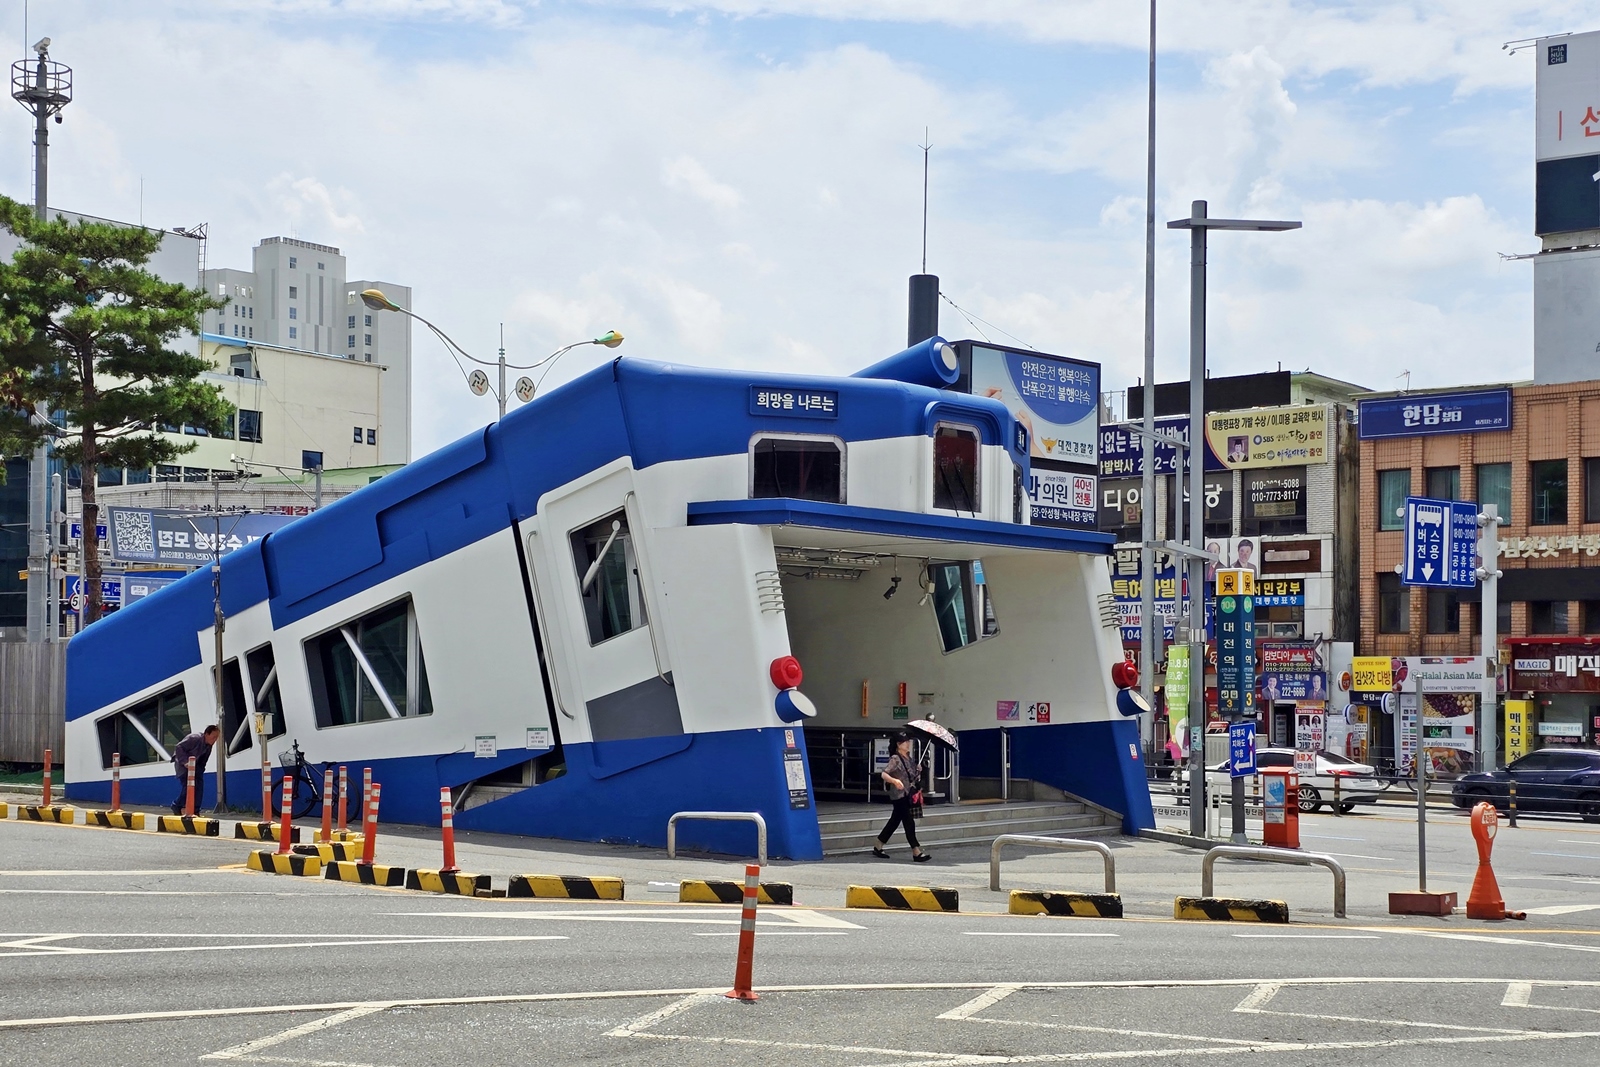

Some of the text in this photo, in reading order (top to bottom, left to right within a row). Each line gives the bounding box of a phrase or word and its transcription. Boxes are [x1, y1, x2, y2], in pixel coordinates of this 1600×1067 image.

[1021, 361, 1091, 387] 안전운전 행복약속
[1021, 380, 1091, 405] 난폭운전 불행약속
[757, 392, 834, 412] 희망을 나르는
[1212, 417, 1240, 431] 대통령표창
[1254, 415, 1267, 428] 수상
[1292, 411, 1310, 423] 교육학
[1311, 410, 1324, 421] 박사
[1402, 404, 1443, 427] 한담
[1309, 430, 1323, 440] 출연
[1058, 440, 1094, 455] 대전경찰청
[1309, 447, 1323, 457] 출연
[1075, 479, 1092, 491] 40년
[1042, 483, 1067, 505] 의원
[1075, 492, 1091, 505] 전통
[1252, 490, 1299, 502] 010-7773-8117
[1418, 528, 1440, 543] 버스
[1417, 544, 1440, 559] 전용
[1453, 542, 1475, 554] 토요일
[1453, 555, 1475, 568] 공휴일
[1453, 569, 1475, 582] 미운영
[1254, 582, 1300, 596] 서민갑부
[1221, 601, 1234, 609] 104
[1223, 622, 1235, 665] 대전역
[1244, 622, 1252, 665] 대전역
[1265, 651, 1290, 661] 캄보디아
[1518, 661, 1548, 669] MAGIC
[1355, 671, 1390, 686] 김삿갓 다방
[1422, 671, 1442, 680] Halal
[1443, 672, 1464, 680] Asian
[1281, 686, 1305, 696] 222-6666
[1246, 692, 1252, 706] 3
[1231, 739, 1246, 747] 지하도
[1234, 749, 1244, 758] 이용
